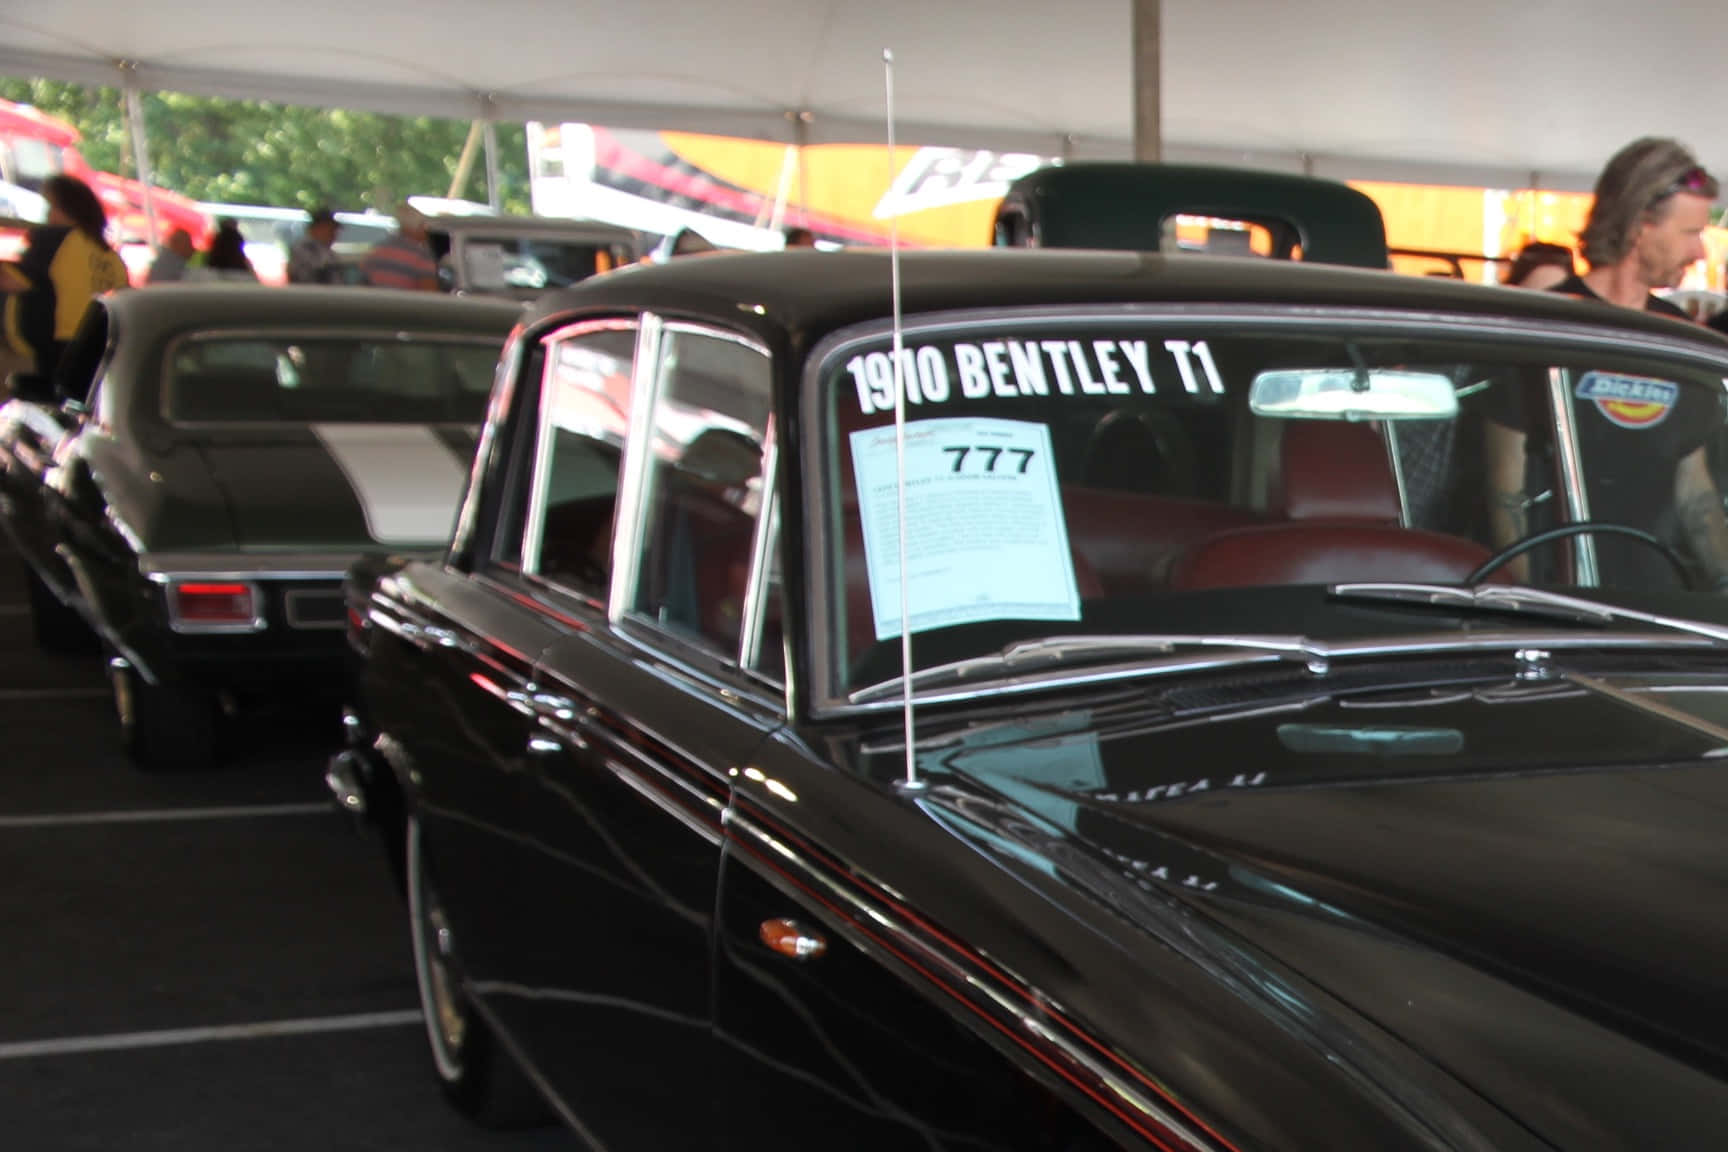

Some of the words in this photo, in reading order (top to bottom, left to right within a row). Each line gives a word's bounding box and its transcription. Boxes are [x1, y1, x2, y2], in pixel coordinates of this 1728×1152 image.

[954, 340, 1157, 399] BENTLEY
[1164, 340, 1225, 395] T1
[942, 445, 1035, 475] 777
